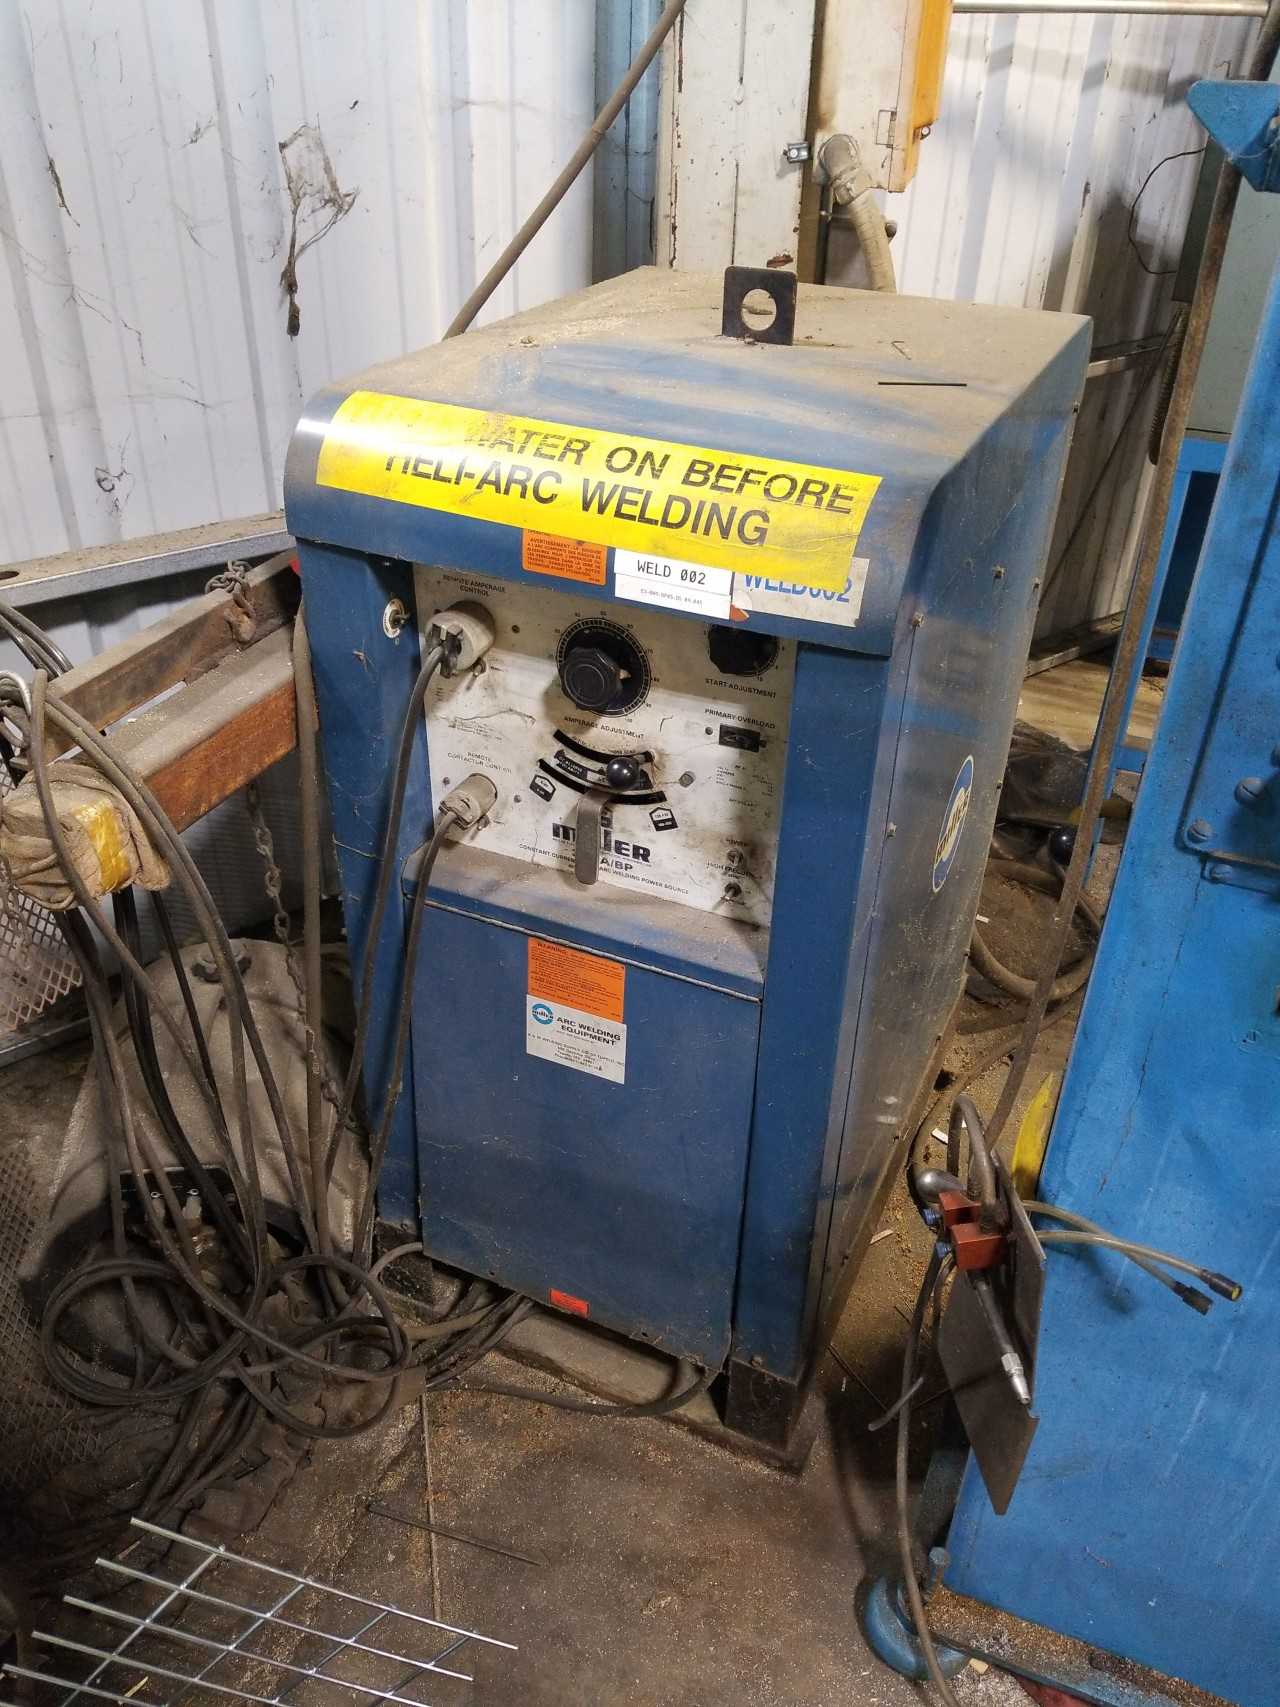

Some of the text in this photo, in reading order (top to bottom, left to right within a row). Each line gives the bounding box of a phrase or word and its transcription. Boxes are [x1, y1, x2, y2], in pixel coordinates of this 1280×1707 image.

[465, 418, 859, 515] ATER ON BEFORE
[581, 478, 771, 547] WELDING
[637, 559, 707, 586] WELD 002
[705, 678, 777, 699] START ADJUSTMENT
[564, 716, 599, 729] AMPERAGE
[705, 708, 776, 729] PRIMARY OVERLOAD
[519, 843, 551, 857] CONSTANT
[613, 870, 641, 882] WELDING
[641, 878, 663, 889] POWER
[664, 883, 689, 895] SOURCE
[556, 1016, 577, 1027] ARC
[578, 1022, 621, 1041] WELDING
[560, 1024, 617, 1047] EQUIPMENT
